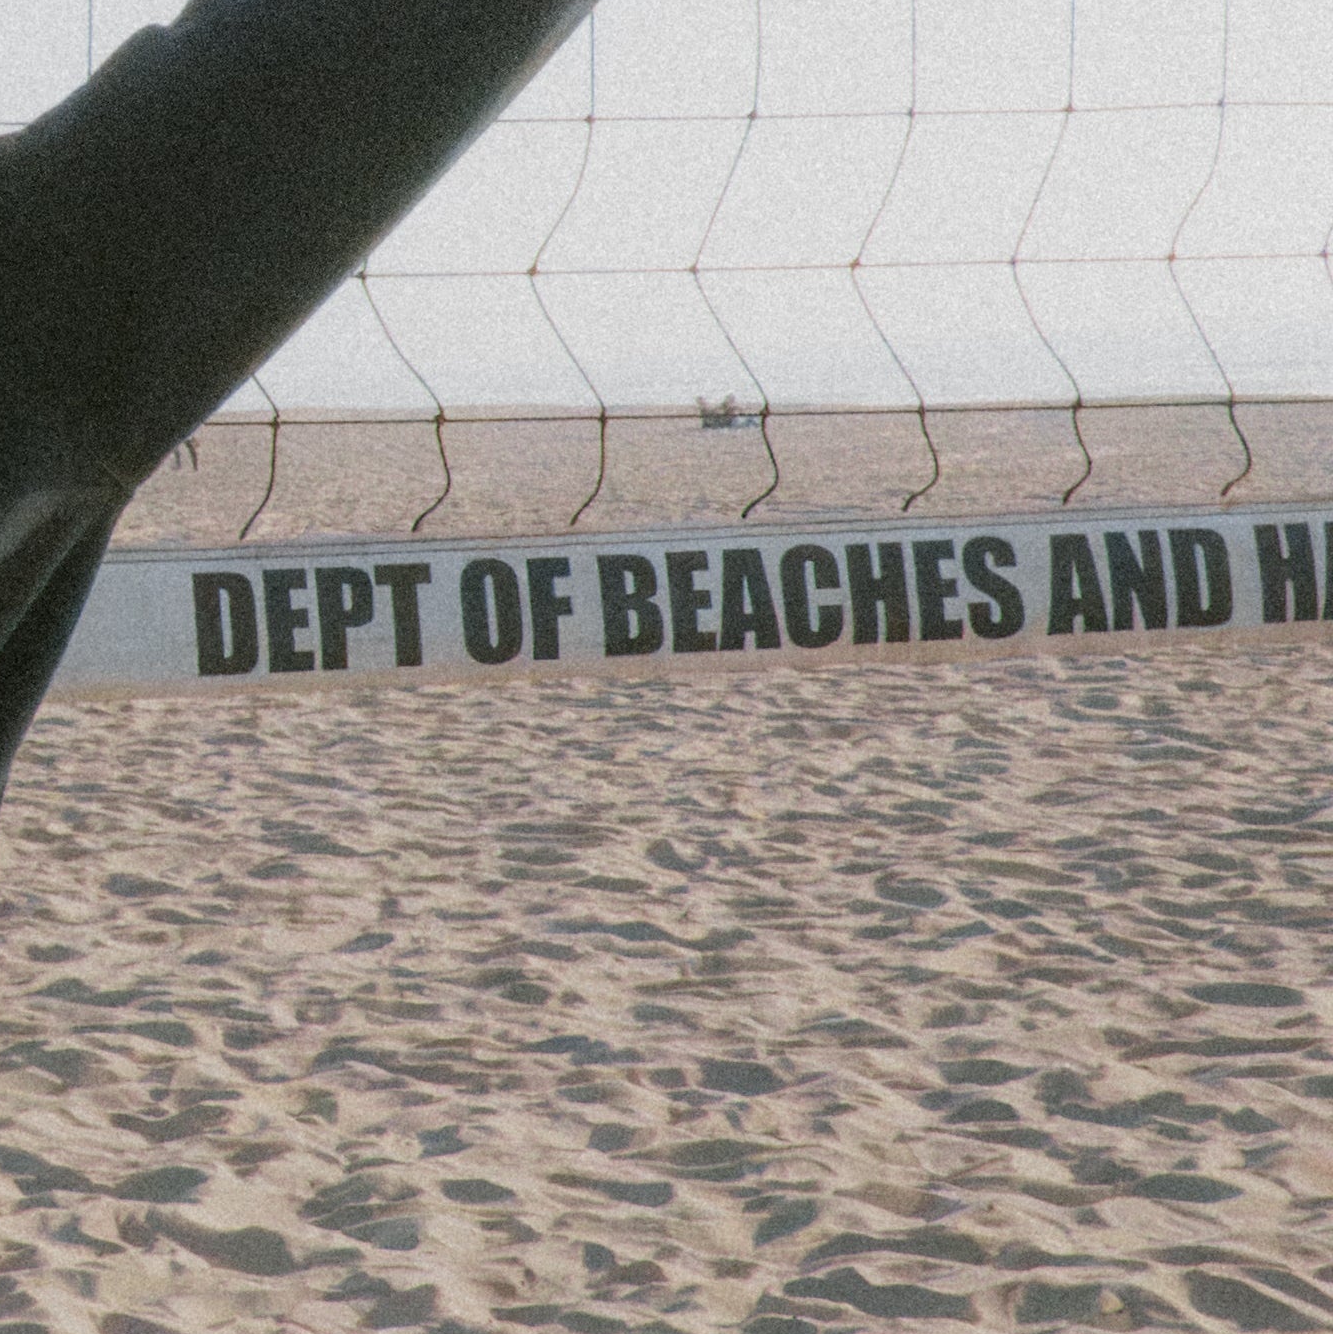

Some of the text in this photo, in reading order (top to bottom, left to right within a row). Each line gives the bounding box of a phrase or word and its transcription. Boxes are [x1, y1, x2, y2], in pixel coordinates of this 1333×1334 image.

[191, 522, 1333, 676] DEPT OF BEACHES AND H
